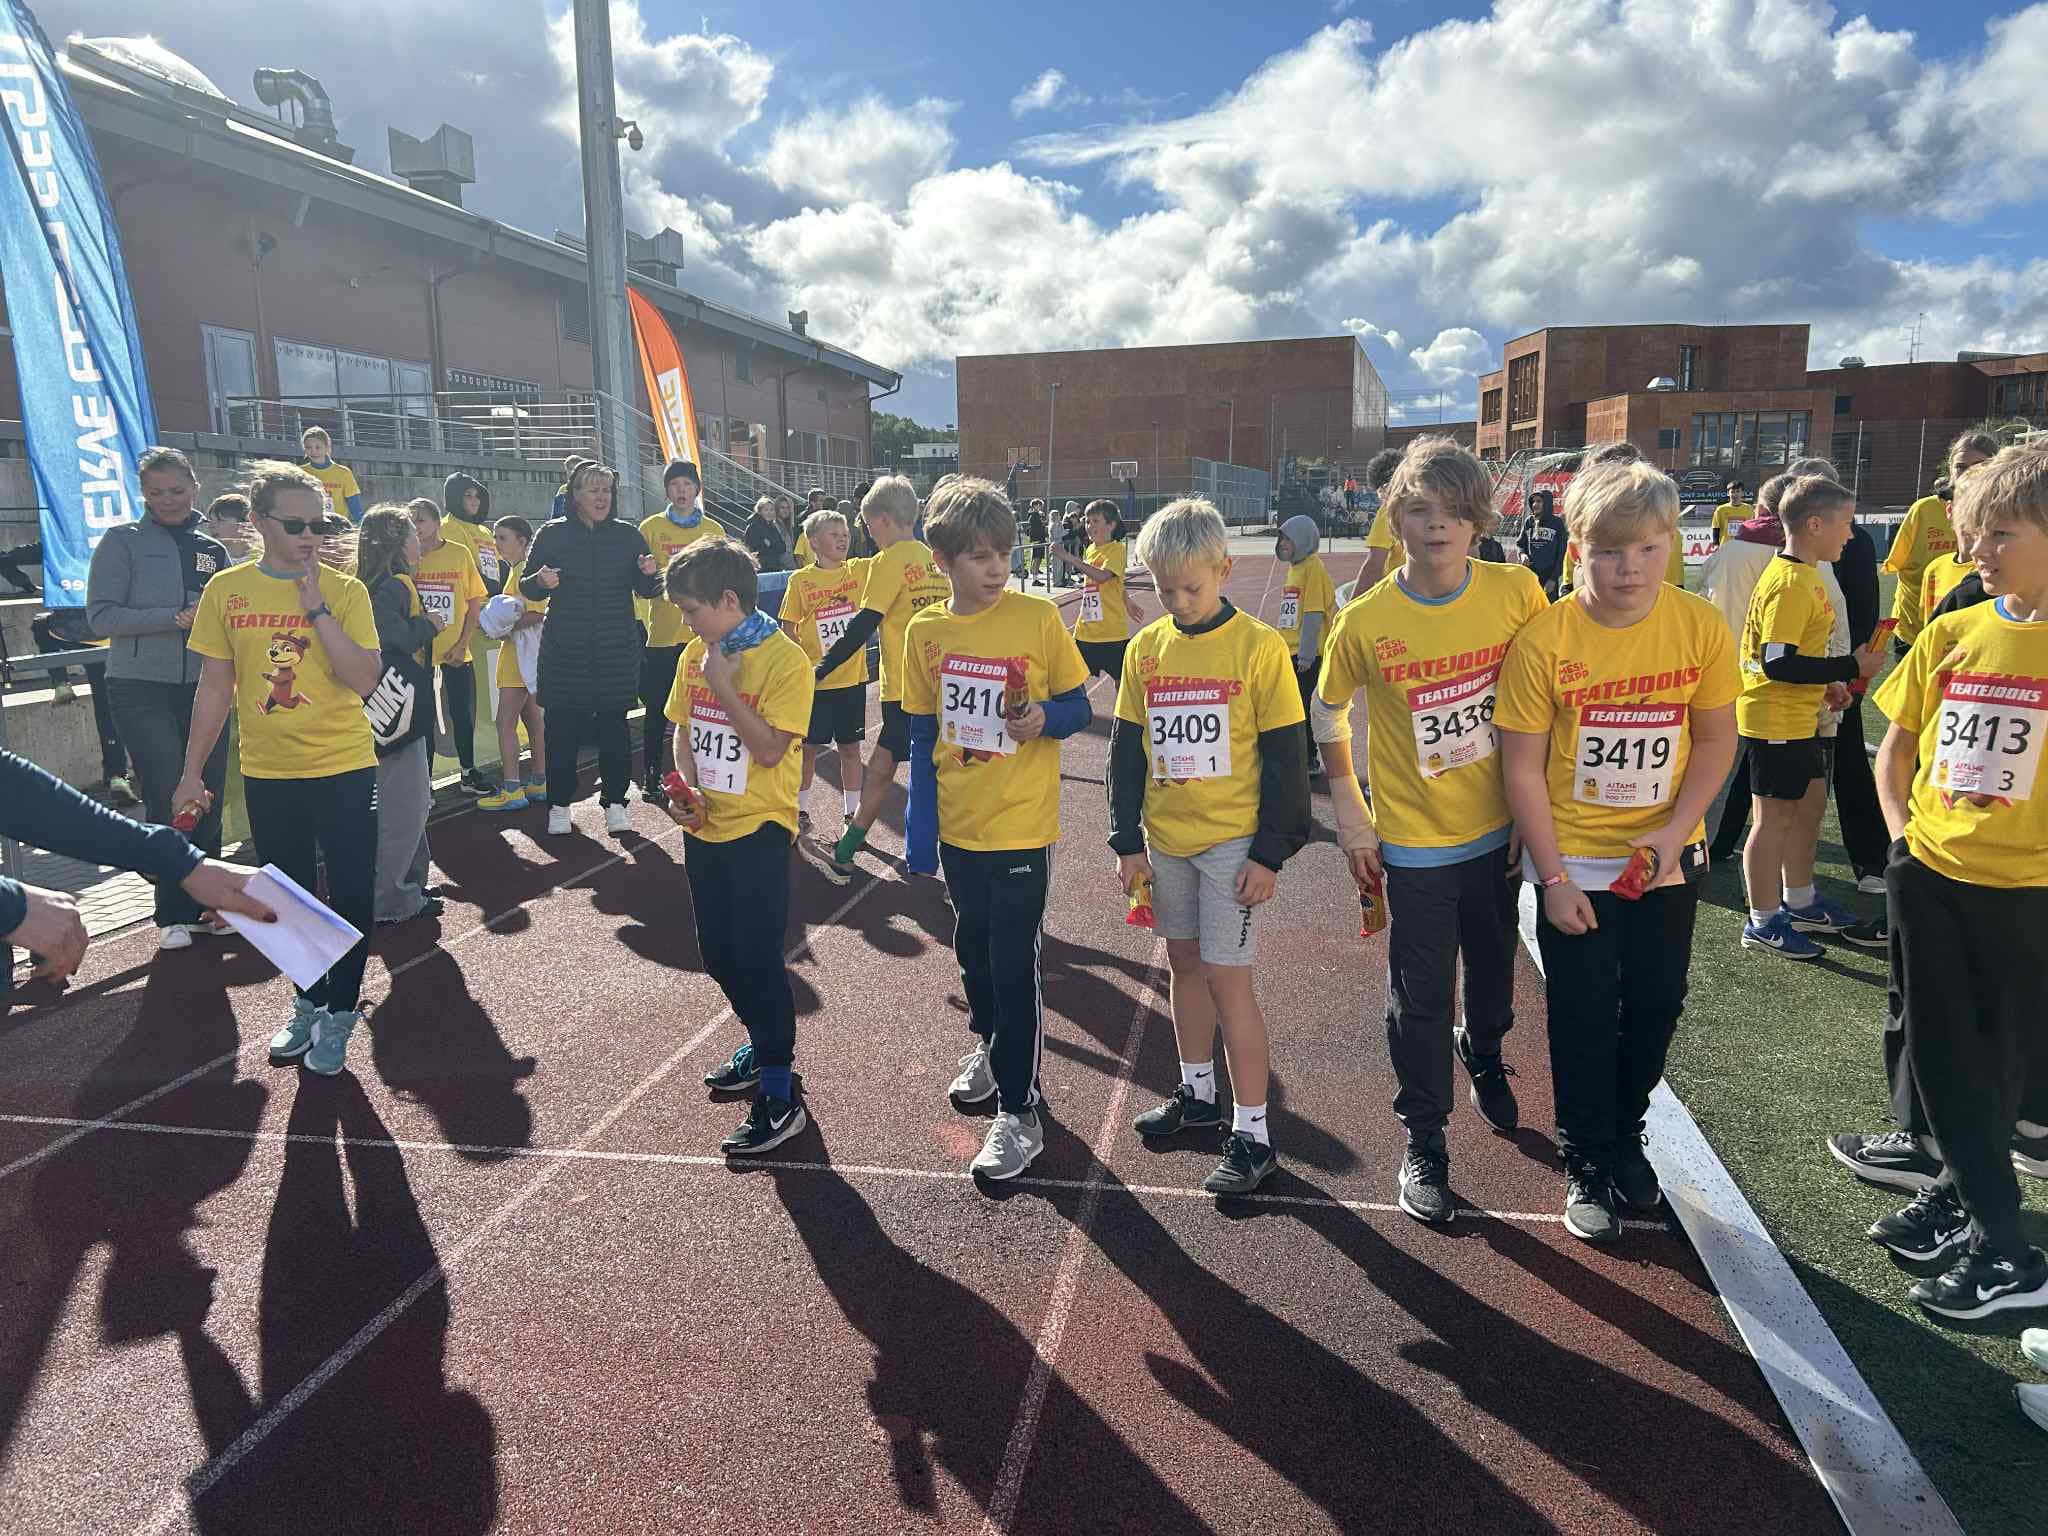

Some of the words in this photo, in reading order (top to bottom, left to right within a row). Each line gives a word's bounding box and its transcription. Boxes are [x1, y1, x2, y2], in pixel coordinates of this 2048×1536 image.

[420, 594, 451, 609] 420
[229, 613, 314, 630] TEATEJOO
[820, 619, 847, 639] 341
[1416, 671, 1494, 705] TEATEJOOKS
[1559, 671, 1590, 686] KAPP
[1562, 666, 1701, 708] TEATEJOOKS
[1153, 689, 1221, 703] TEATEJOOKS
[1949, 682, 2043, 703] TEATEJOOKS
[694, 705, 728, 720] TEATEJO
[1421, 695, 1495, 745] 3438
[1588, 710, 1677, 723] TEATEJOOKS
[1153, 713, 1221, 745] 3409
[1941, 711, 2032, 755] 3413
[692, 726, 743, 762] 3413
[997, 732, 1003, 748] 1
[1488, 732, 1495, 748] 1
[1583, 736, 1669, 770] 3419
[1208, 756, 1216, 772] 1
[727, 773, 734, 789] 1
[1997, 770, 2015, 791] 3
[1652, 782, 1659, 800] 1
[1239, 906, 1252, 948] pion
